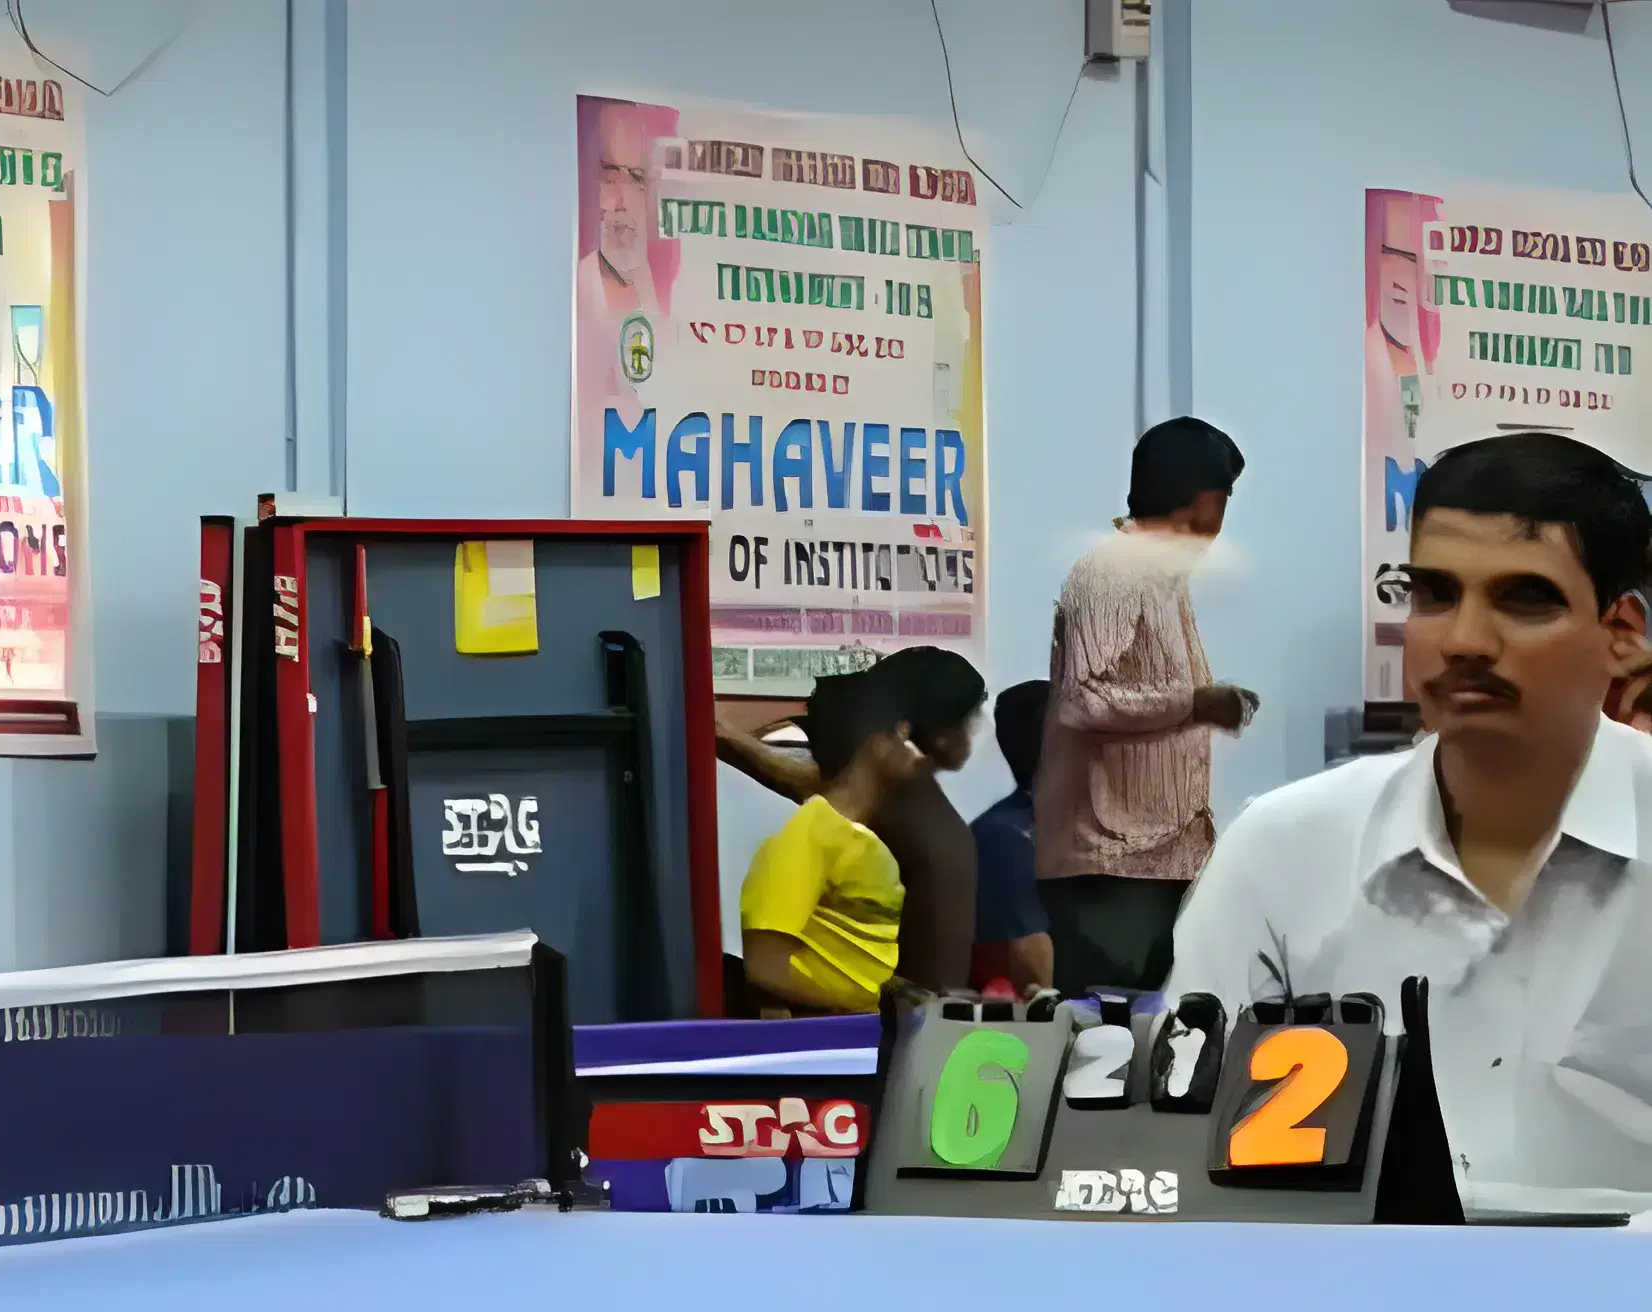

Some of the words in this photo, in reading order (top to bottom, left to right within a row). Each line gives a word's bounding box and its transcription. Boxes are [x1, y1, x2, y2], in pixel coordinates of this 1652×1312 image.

[602, 408, 969, 526] MAHAVEER
[728, 534, 769, 589] OF
[930, 1030, 1030, 1166] 6
[1063, 1024, 1136, 1099] 2
[1229, 1027, 1349, 1167] 2
